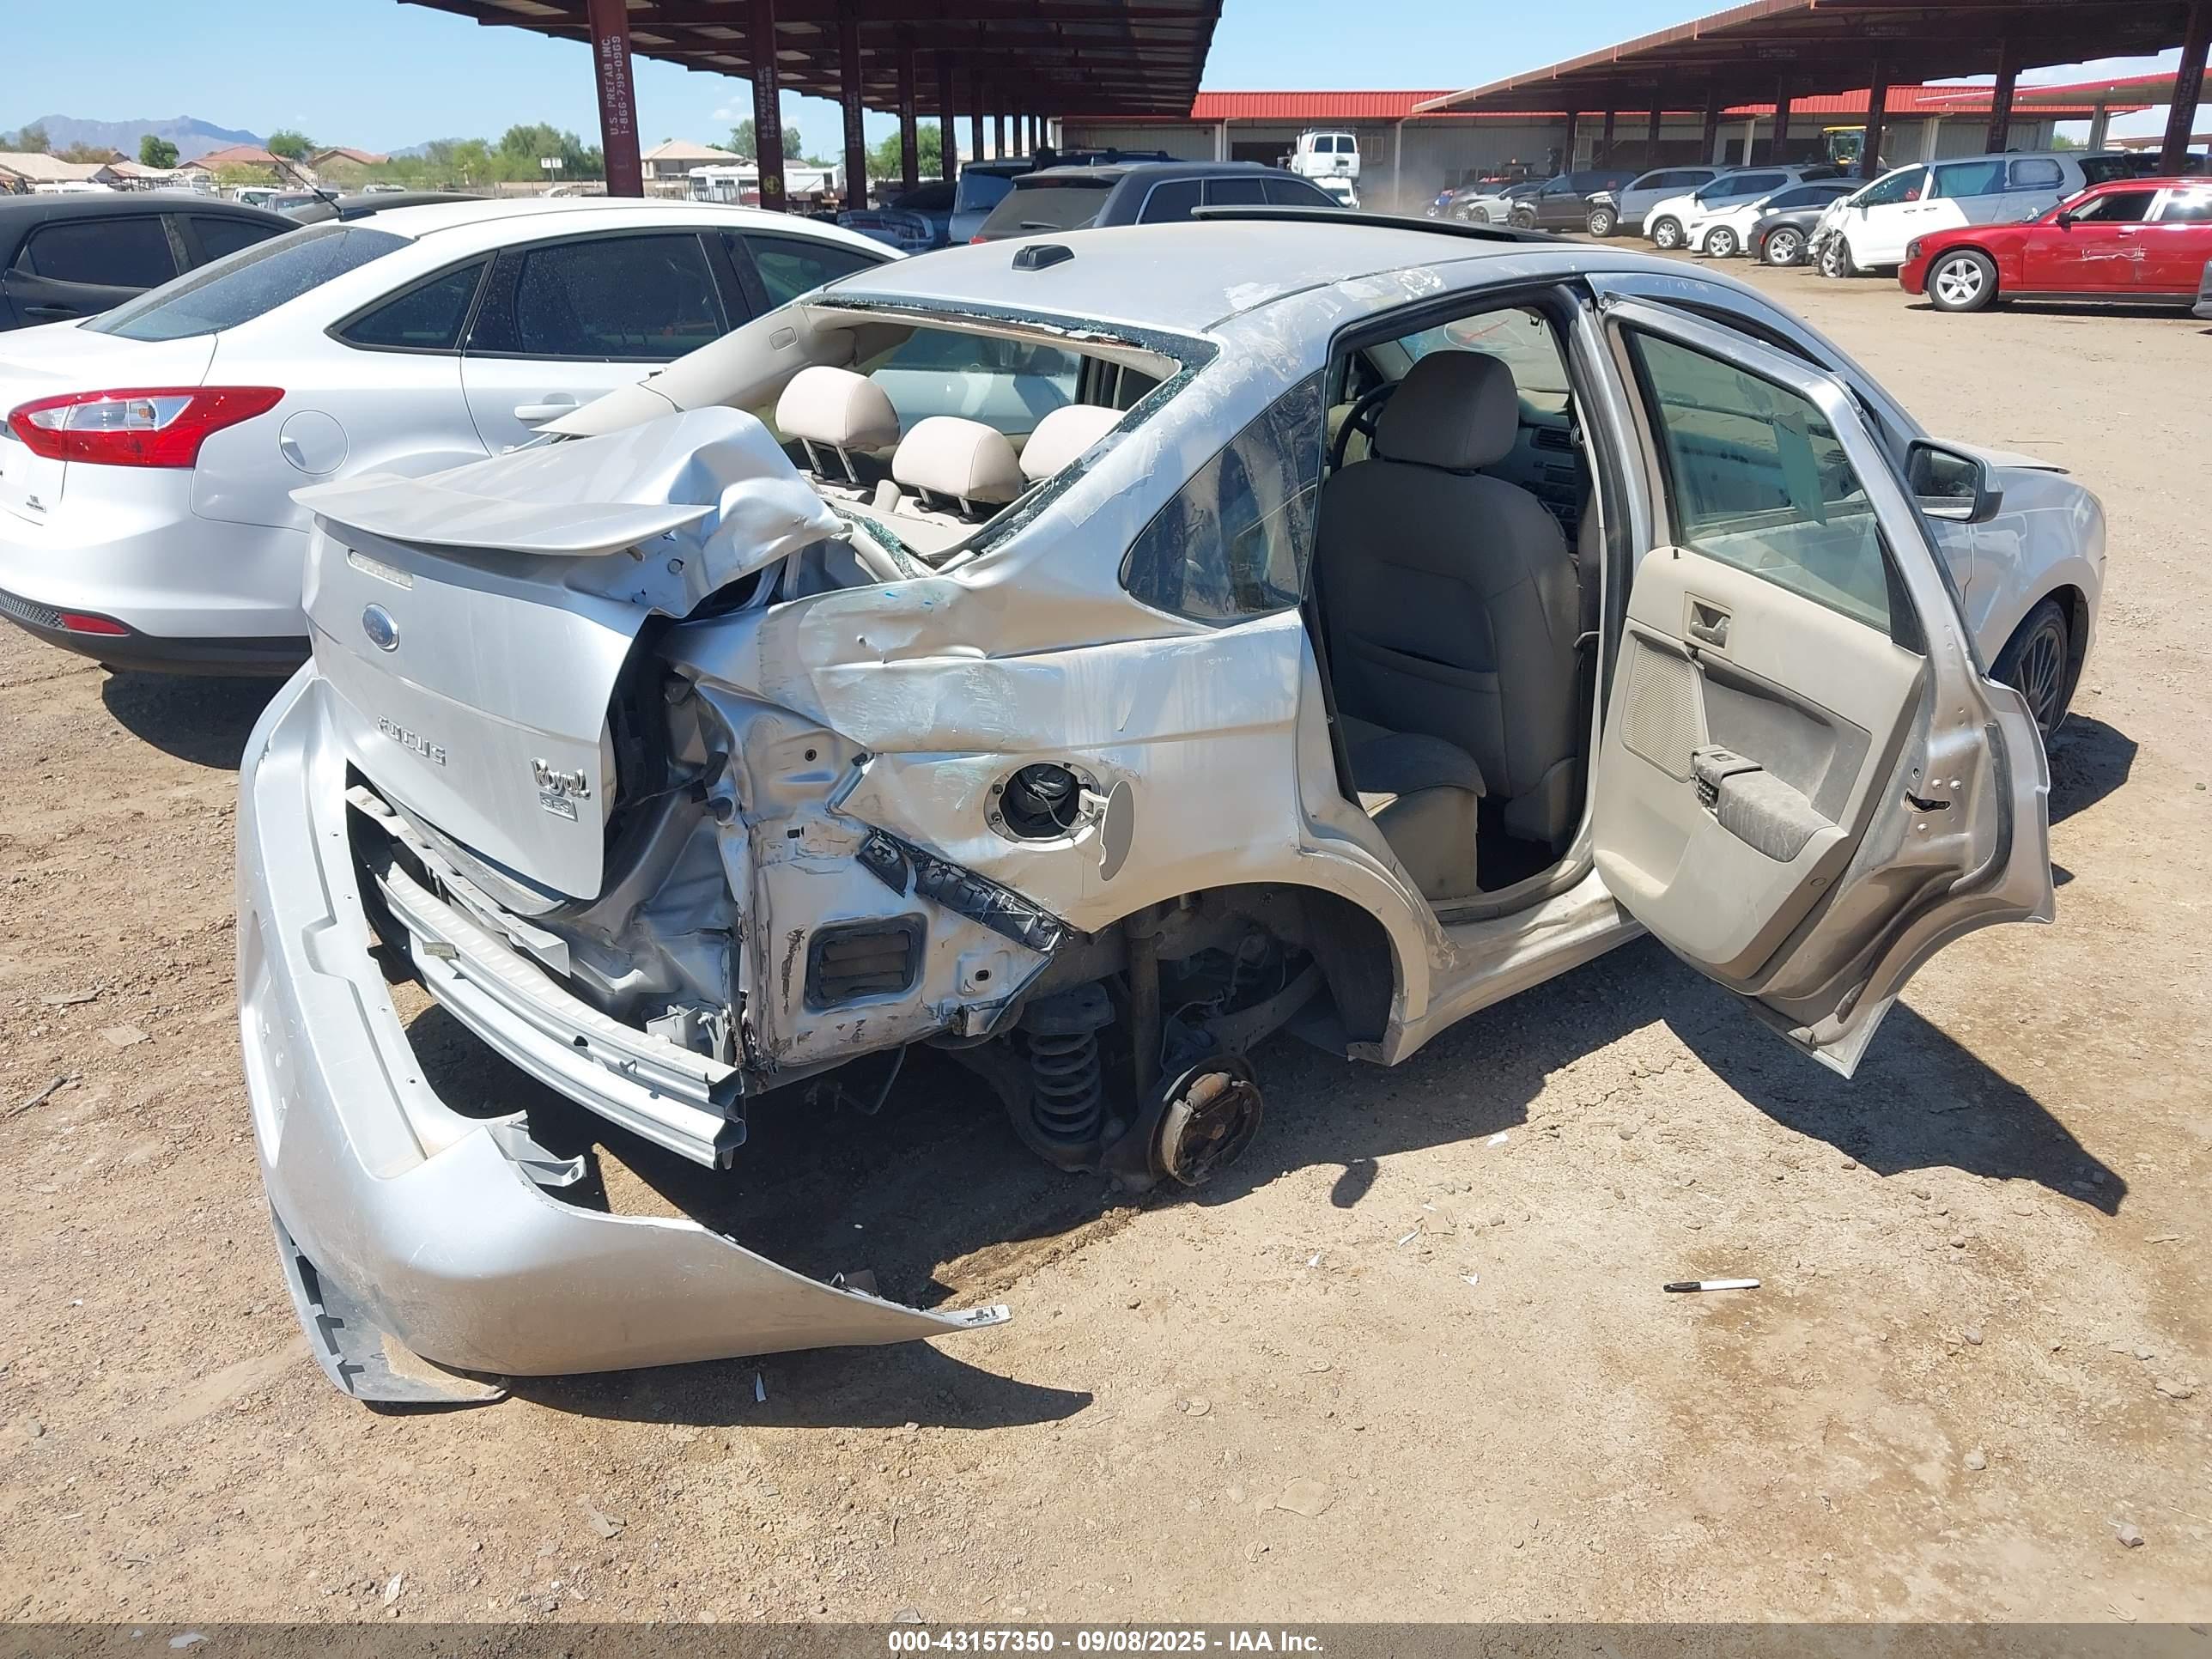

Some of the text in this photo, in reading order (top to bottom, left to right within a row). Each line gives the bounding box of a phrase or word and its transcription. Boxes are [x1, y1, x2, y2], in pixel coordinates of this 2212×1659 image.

[602, 35, 620, 136] U.S. PREFAB INC.
[612, 36, 629, 134] 1-866-799-0969
[377, 714, 447, 766] FOCUS
[530, 756, 592, 800] Royal
[541, 797, 570, 813] SES
